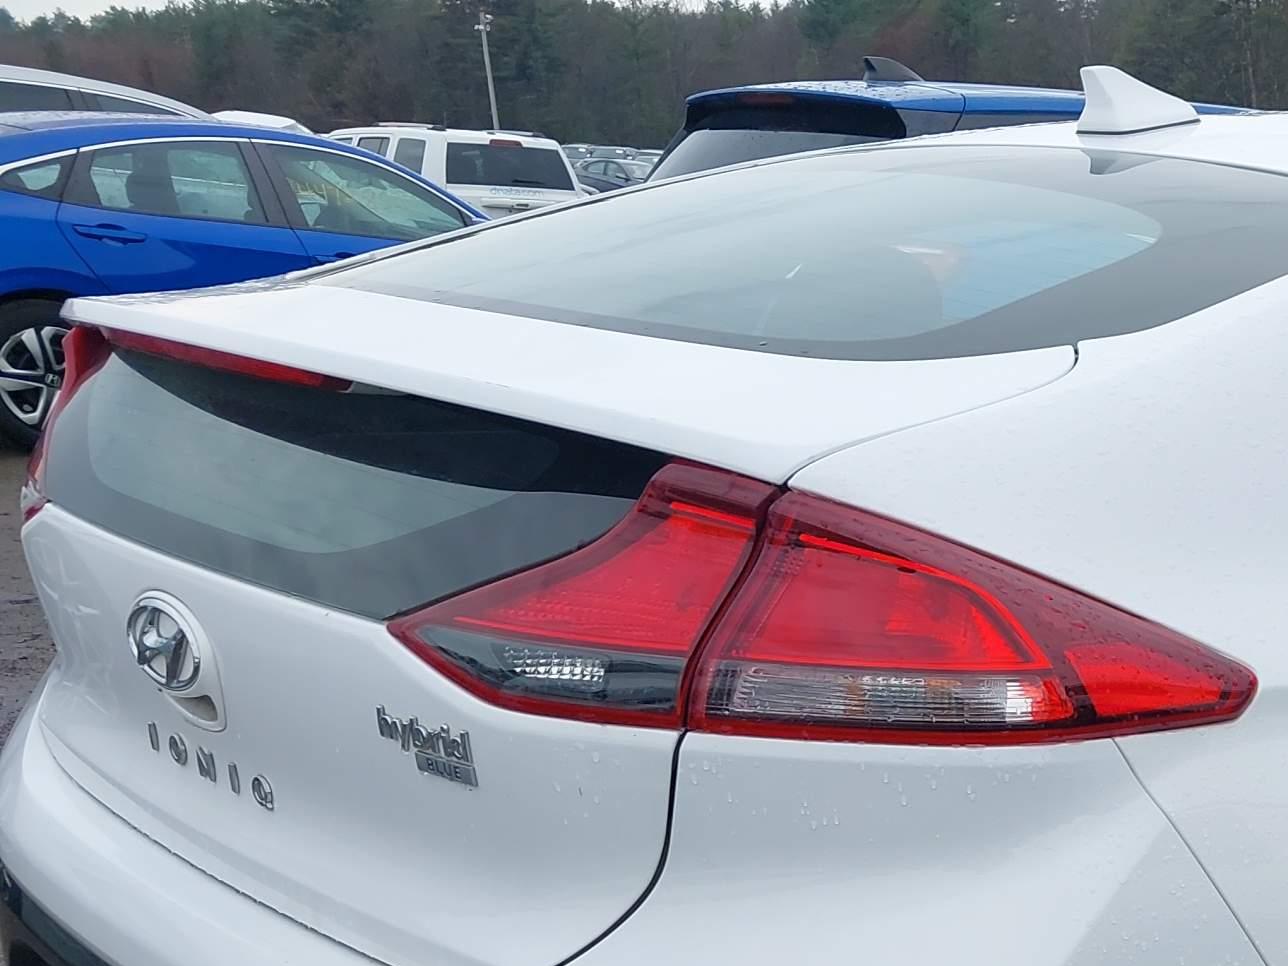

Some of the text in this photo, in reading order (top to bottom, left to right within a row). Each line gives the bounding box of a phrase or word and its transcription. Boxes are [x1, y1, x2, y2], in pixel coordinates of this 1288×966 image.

[376, 704, 473, 763] hybrid
[147, 721, 275, 811] IONIQ
[426, 757, 463, 780] BLUE
